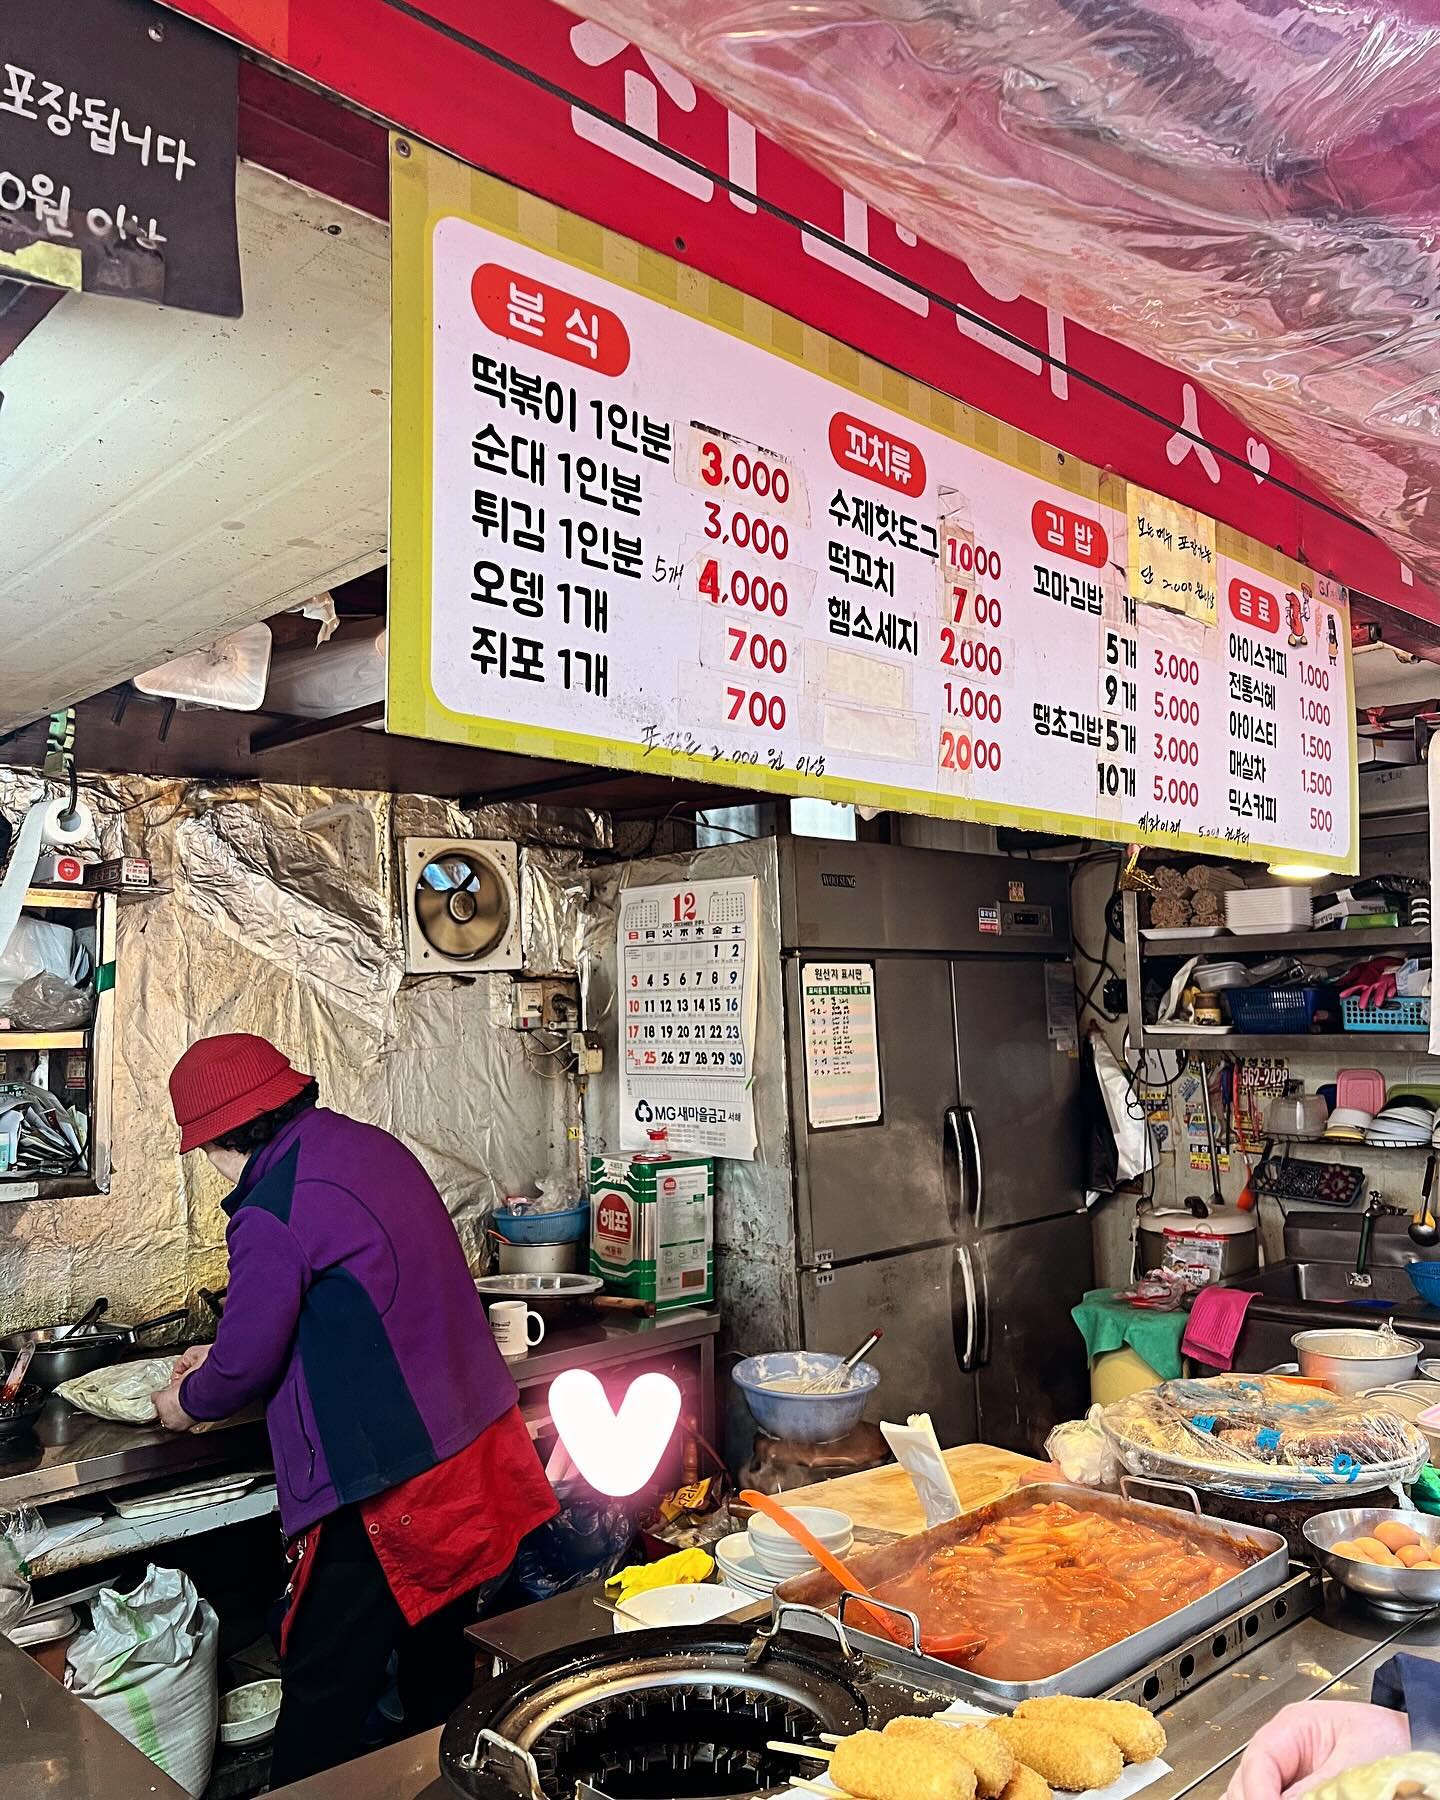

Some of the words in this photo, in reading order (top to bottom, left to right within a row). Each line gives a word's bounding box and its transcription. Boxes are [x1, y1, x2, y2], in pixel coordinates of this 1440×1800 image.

[0, 63, 196, 181] 포장됩니다
[471, 353, 576, 432] 떡볶이
[589, 400, 672, 464] 1인분
[701, 441, 790, 504] 3,000
[845, 424, 912, 486] 꼬치류
[471, 423, 545, 487] 순대
[558, 452, 643, 517] 1인분
[703, 500, 789, 561] 3,000
[471, 489, 545, 554] 튀김
[558, 518, 644, 579] 1인분
[828, 488, 939, 559] 수제핫도그
[698, 559, 788, 617] 4,000
[828, 540, 894, 598] 떡꼬치
[1033, 564, 1104, 616] 꼬마김밥
[470, 560, 545, 618] 오뎅
[557, 583, 608, 633] 1개
[727, 627, 787, 674] 700
[828, 596, 918, 656] 햄소세지
[940, 627, 1001, 676] 2,000
[470, 626, 545, 683] 쥐포
[558, 649, 608, 698] 1개
[727, 687, 787, 731] 700
[1106, 633, 1136, 669] 5개
[1154, 649, 1199, 686] 3,000
[1229, 633, 1287, 678] 아이스커피
[1298, 661, 1329, 691] 1,000
[943, 682, 1001, 723] 1,000
[1154, 691, 1199, 727] 5,000
[1229, 671, 1276, 711] 전통식혜
[1299, 696, 1330, 727] 1,000
[1033, 702, 1103, 748] 땡초김밥
[1106, 719, 1136, 754] 5개
[1153, 733, 1199, 767] 3,000
[1229, 710, 1277, 749] 아이스티
[1301, 733, 1332, 762] 1,500
[1097, 762, 1136, 797] 10개
[1153, 775, 1199, 807] 5,000
[1229, 749, 1266, 783] 매실차
[1301, 769, 1332, 797] 1,500
[1229, 788, 1277, 823] 믹스커피
[1309, 807, 1332, 832] 500
[662, 929, 673, 938] 火
[712, 926, 722, 934] 金
[731, 925, 741, 934] 土
[673, 892, 696, 922] 12
[714, 944, 718, 957] 1
[732, 944, 739, 957] 2
[815, 968, 838, 980] 원산지
[629, 1000, 640, 1012] 10
[645, 1000, 655, 1012] 11
[660, 1000, 672, 1012] 12
[677, 999, 688, 1011] 13
[694, 999, 705, 1011] 14
[710, 998, 720, 1011] 15
[726, 998, 738, 1011] 16
[631, 975, 638, 987] 3
[647, 974, 654, 986] 4
[663, 973, 669, 986] 5
[680, 973, 686, 985] 6
[696, 972, 702, 985] 7
[712, 971, 718, 984] 8
[730, 971, 737, 984] 9
[629, 1026, 639, 1038] 17
[644, 1026, 655, 1038] 18
[661, 1026, 673, 1038] 19
[677, 1025, 689, 1038] 20
[694, 1025, 705, 1038] 21
[710, 1025, 722, 1038] 22
[726, 1026, 739, 1039] 23
[644, 1052, 656, 1064] 25
[662, 1052, 673, 1064] 26
[679, 1051, 690, 1064] 27
[695, 1052, 707, 1065] 28
[711, 1052, 724, 1065] 29
[730, 1052, 742, 1065] 30
[600, 1208, 628, 1232] 해표
